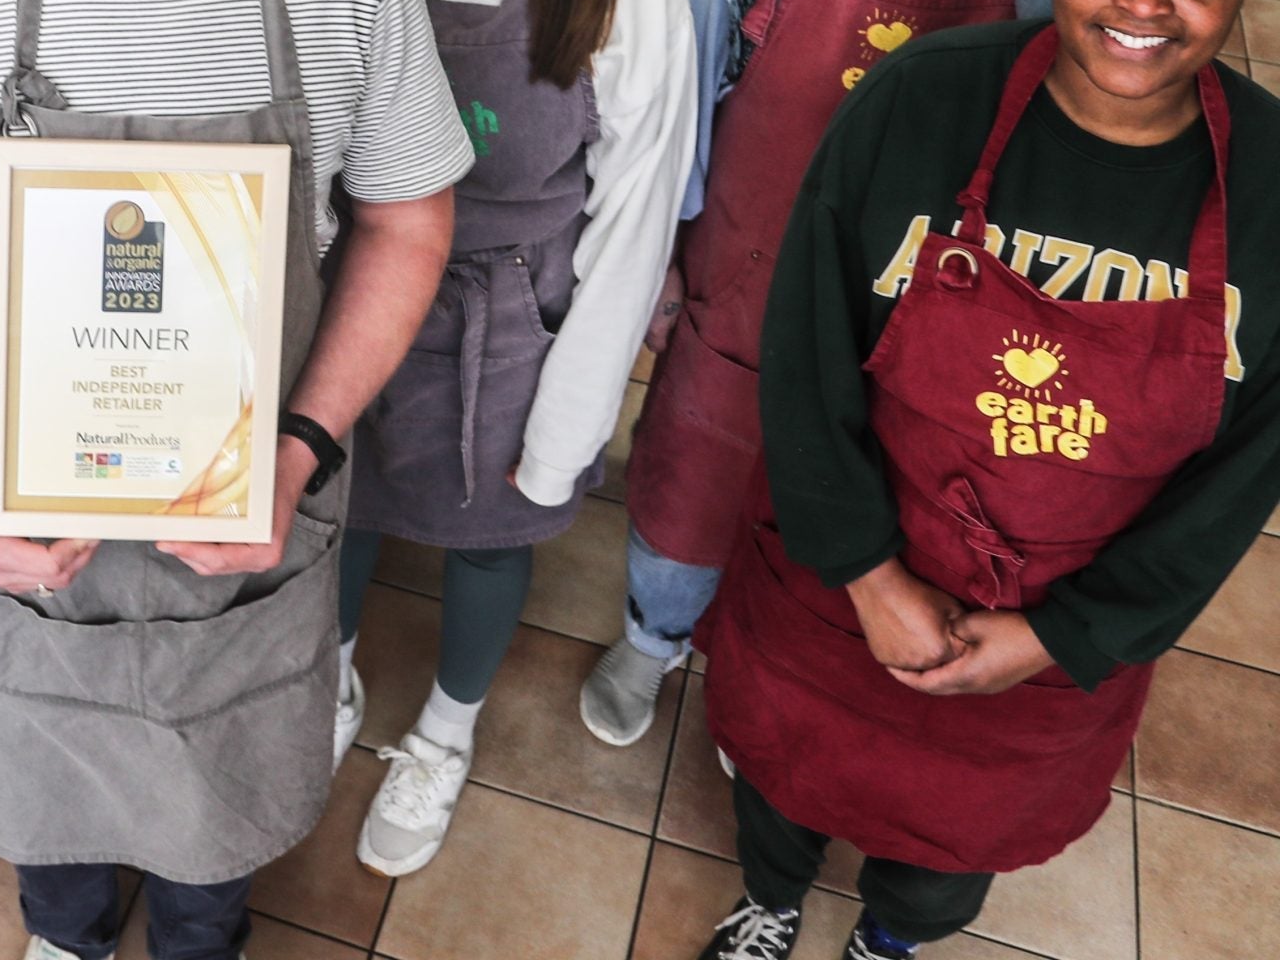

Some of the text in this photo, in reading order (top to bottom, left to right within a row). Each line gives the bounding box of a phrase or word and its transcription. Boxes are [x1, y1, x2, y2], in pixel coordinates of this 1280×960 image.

[105, 242, 162, 258] natural
[104, 271, 161, 281] INNOVATION
[104, 279, 161, 292] AWARDS
[104, 292, 160, 309] 2023
[71, 326, 190, 352] WINNER
[110, 365, 148, 378] BEST
[72, 380, 184, 395] INDEPENDENT
[92, 397, 163, 411] RETAILER
[974, 389, 1108, 438] earth
[989, 417, 1092, 461] fare
